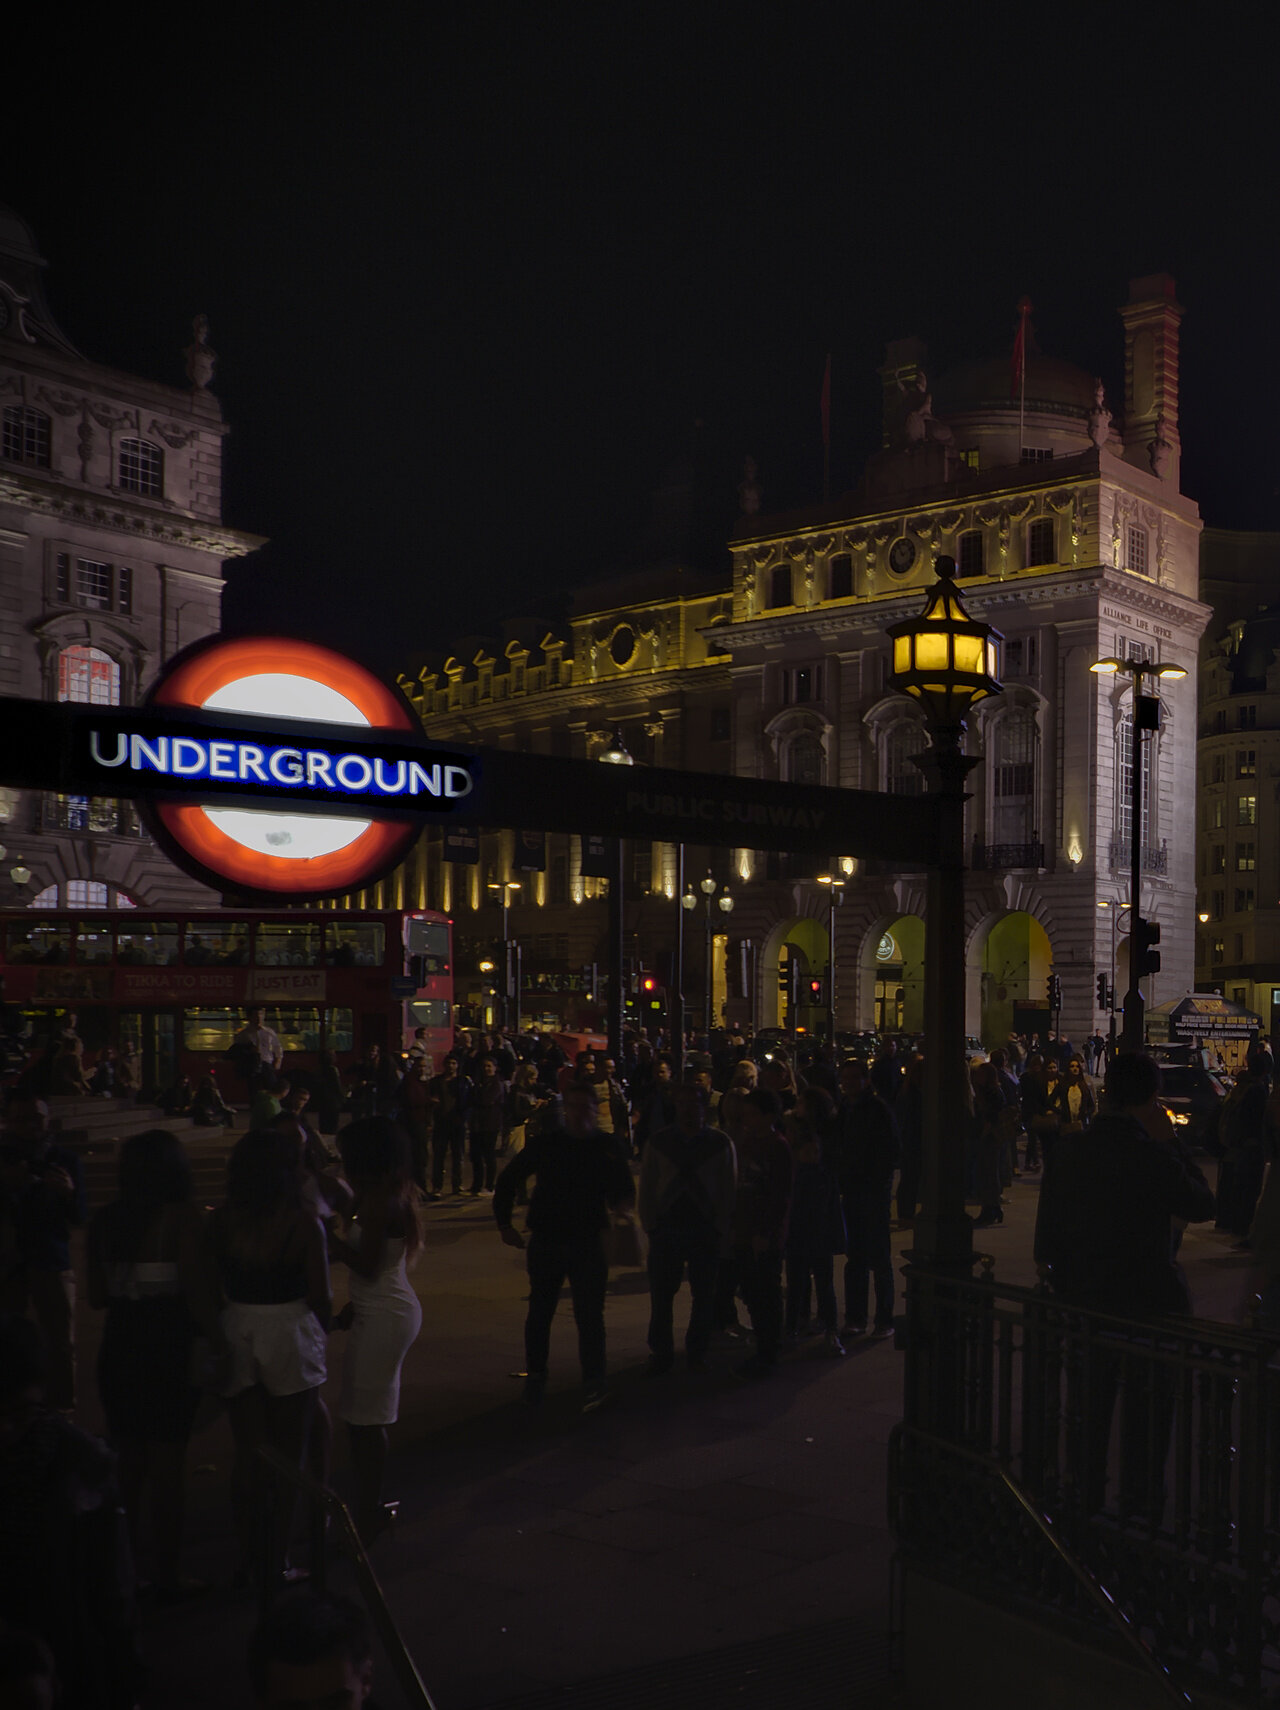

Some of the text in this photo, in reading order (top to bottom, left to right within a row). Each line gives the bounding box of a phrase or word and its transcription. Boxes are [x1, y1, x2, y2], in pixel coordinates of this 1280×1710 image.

[1103, 606, 1172, 639] ALLIANCE LIFE OFFICE
[90, 731, 473, 798] UNDERGROUND
[626, 791, 826, 829] PUBLIC SUBWAY
[125, 974, 235, 988] TIKKA TO RIDE
[254, 974, 321, 990] JUST EAT
